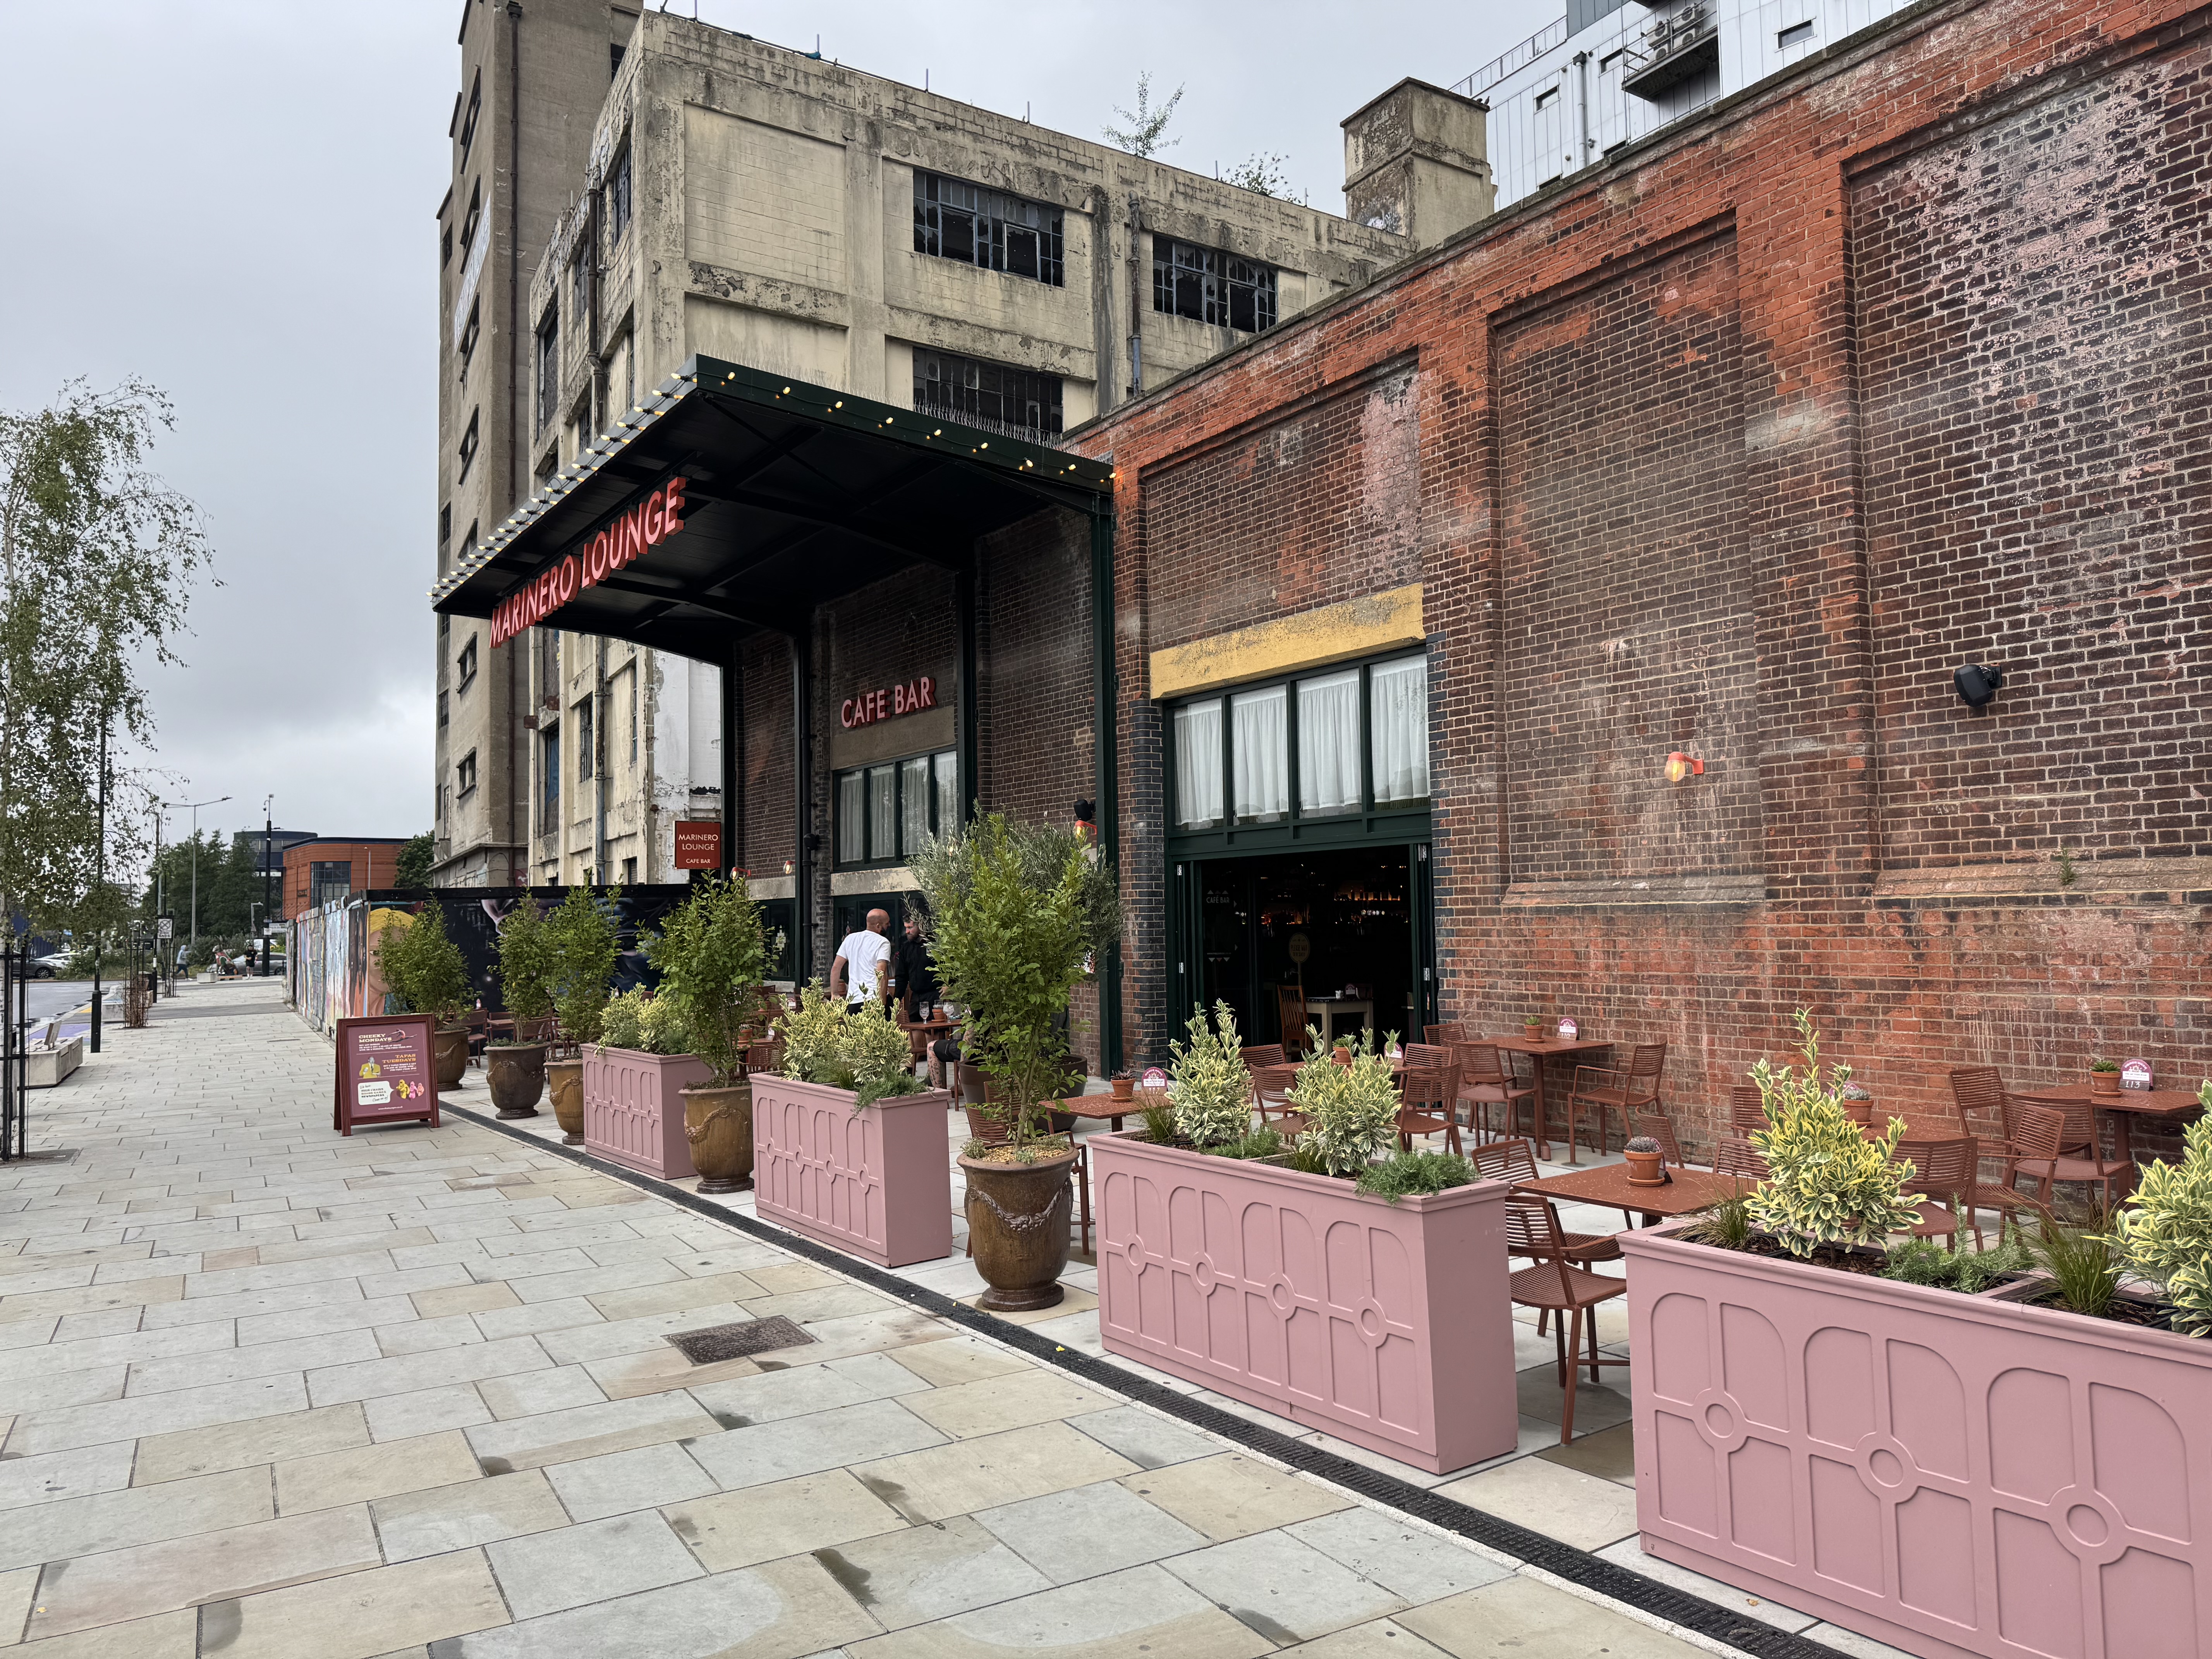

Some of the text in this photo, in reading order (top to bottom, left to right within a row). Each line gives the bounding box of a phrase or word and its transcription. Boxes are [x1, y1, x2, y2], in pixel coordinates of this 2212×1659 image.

[489, 477, 686, 648] MARINERO LOUNGE
[841, 677, 934, 728] CAFE BAR
[1206, 895, 1219, 903] CAFÉ
[2125, 1080, 2140, 1089] 113
